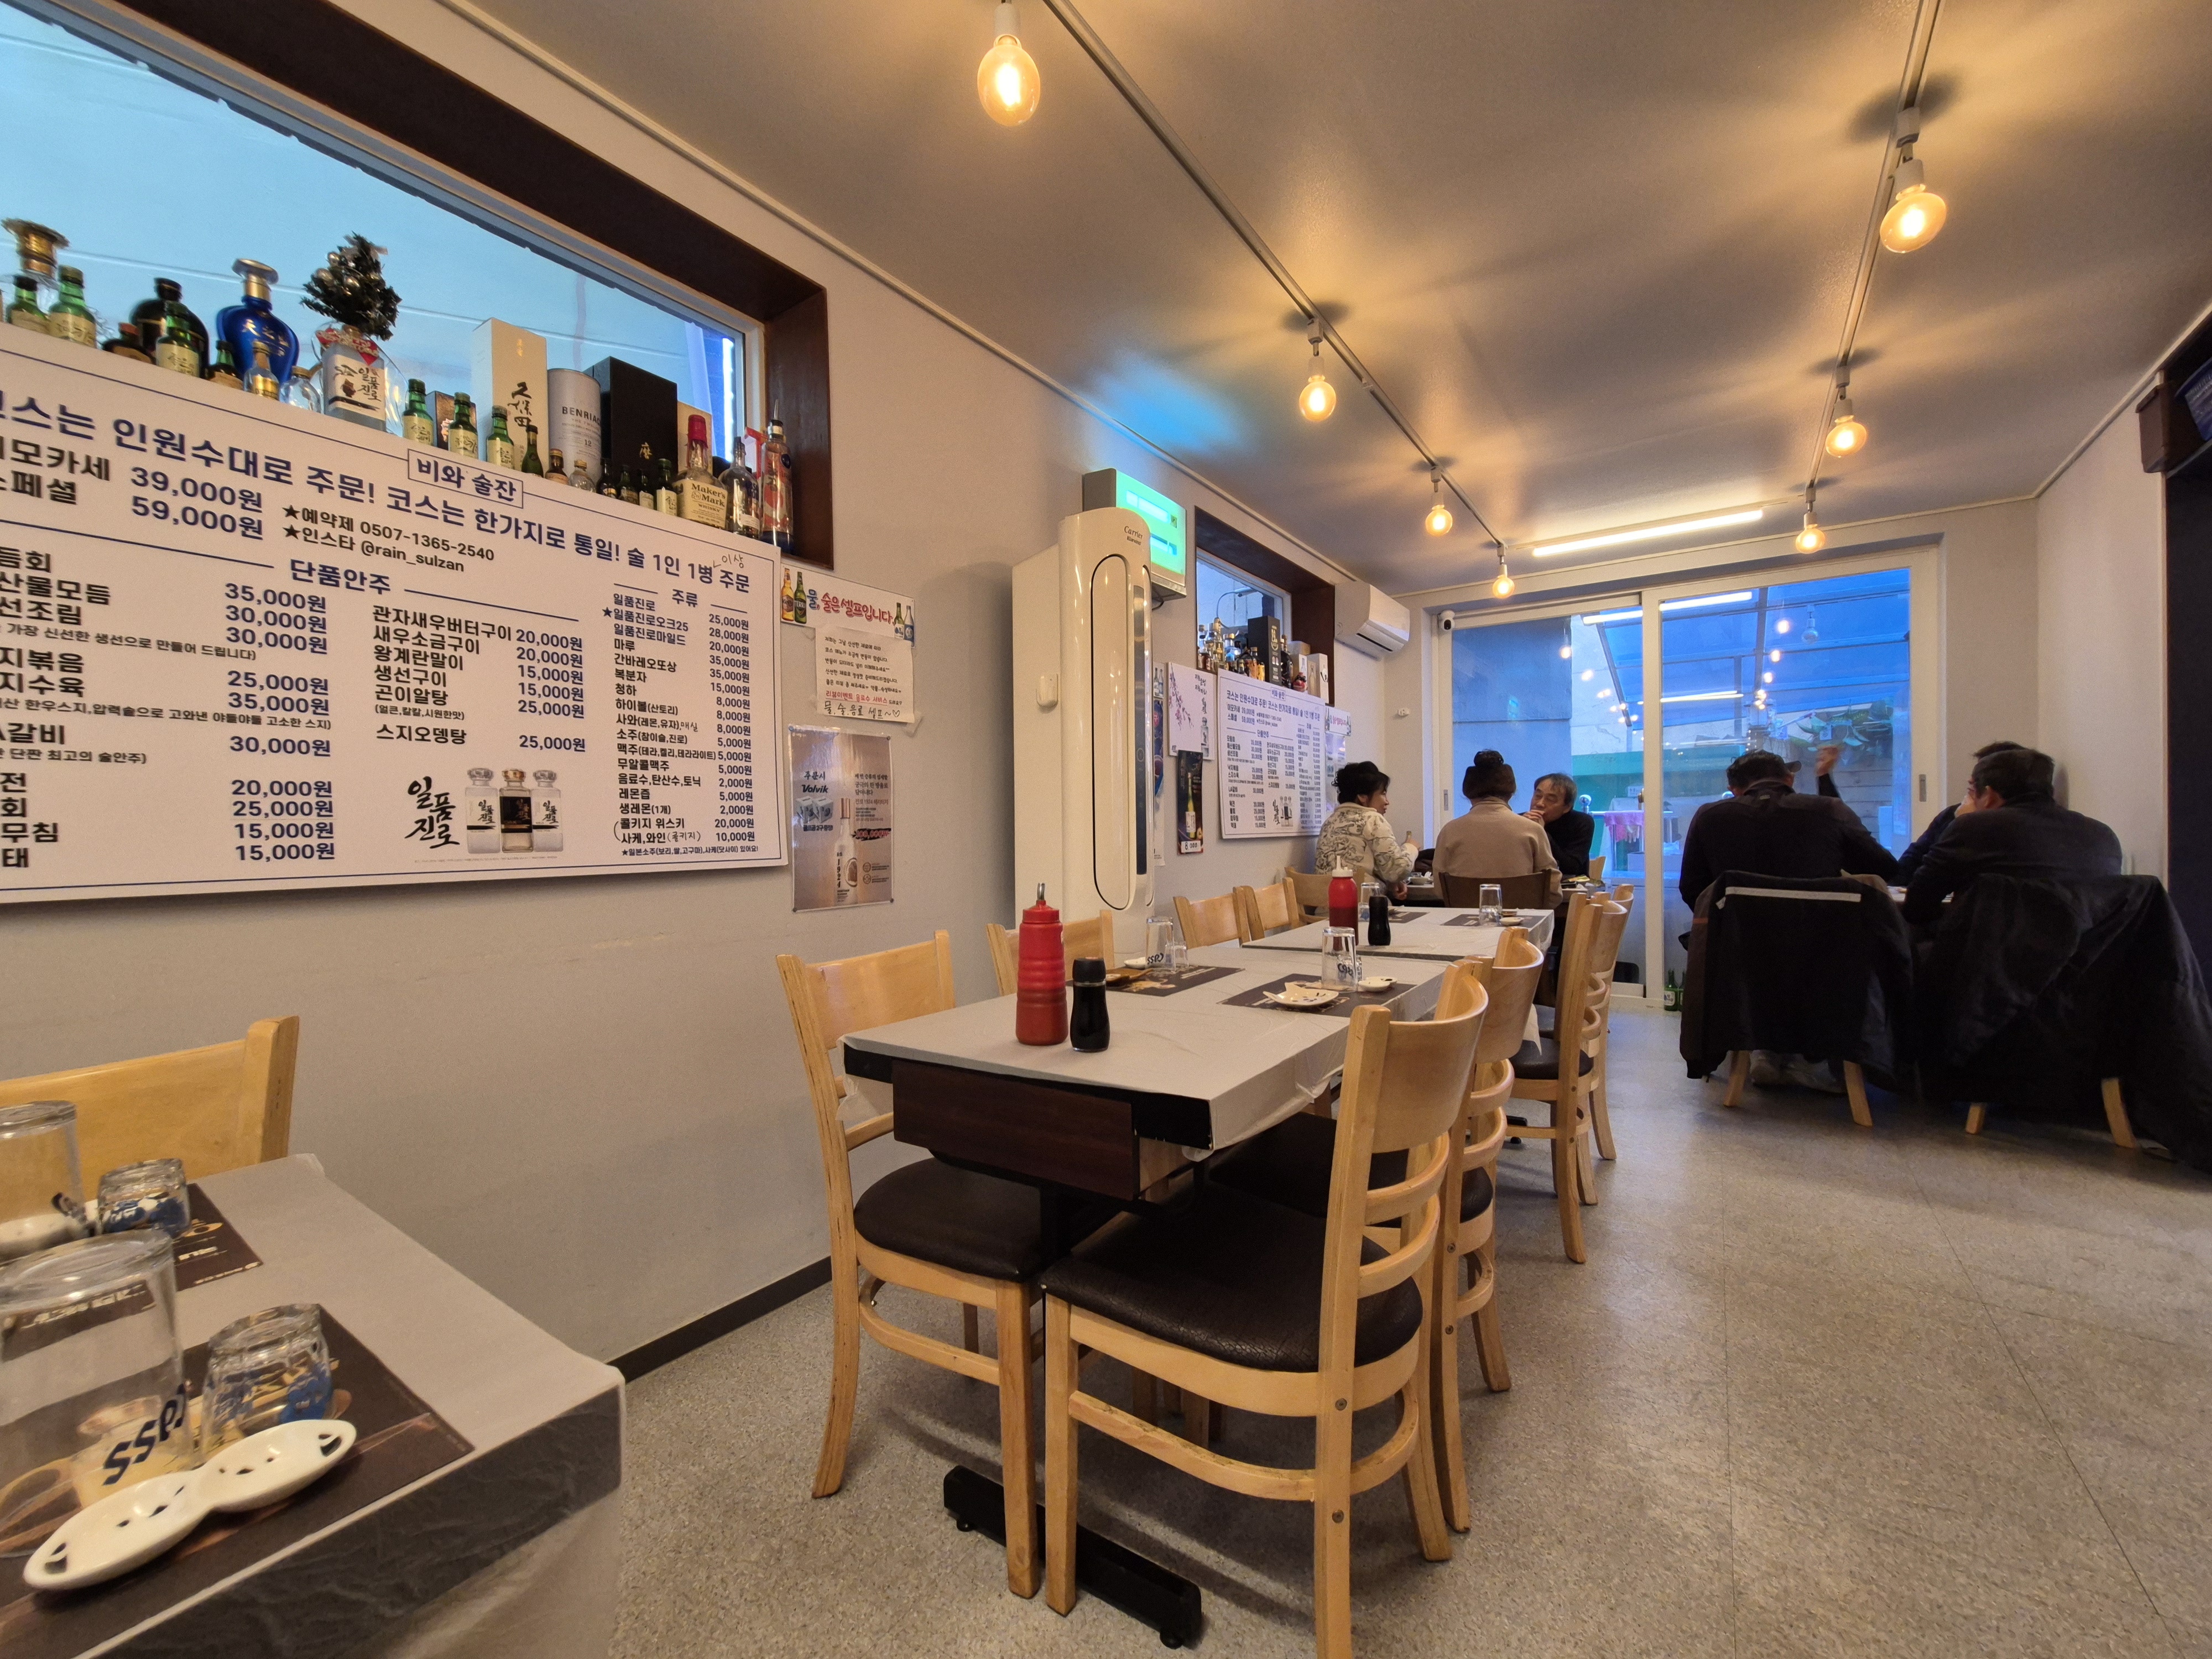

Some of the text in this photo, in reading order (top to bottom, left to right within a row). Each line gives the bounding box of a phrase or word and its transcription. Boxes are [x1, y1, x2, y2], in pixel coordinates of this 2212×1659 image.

[0, 436, 262, 513] 모카세 39,000원
[417, 458, 517, 502] 비와 술잔
[0, 390, 749, 593] 스는 인원수대로 주문! 코스는 한가지로 통일! 술 1인 1병 주문
[692, 483, 726, 499] Maker's
[701, 494, 725, 507] Mark
[0, 470, 263, 540] 페셜 59,000원
[361, 521, 494, 560] 0507-1365-2540
[1124, 526, 1143, 540] Carrier
[361, 539, 463, 572] @rain_sulzan
[722, 552, 744, 568] 이상
[291, 559, 390, 594] 단품안주
[225, 583, 326, 613] 35,000원
[672, 589, 697, 607] 주류
[226, 605, 326, 634] 30,000원
[614, 593, 748, 630] 일품진로 25,000원
[373, 605, 582, 652] 관자새우버터구이 20,000원
[614, 608, 749, 644] 일품진로오크25 28,000원
[8, 623, 255, 660] 가장 신선한 생선으로 만들어 드립니다)
[226, 627, 327, 654] 30,000원
[373, 625, 583, 669] 새우소금구이 20,000원
[614, 623, 749, 657] 일품진로마일드 20,000원
[374, 644, 583, 685] 왕계란말이 15,000원
[614, 638, 749, 670] 마루 35,000원
[614, 653, 749, 683] 간바레오또상 35,000원
[228, 671, 328, 695] 25,000원
[374, 665, 583, 702] 생선구이 15,000원
[615, 668, 749, 696] 복분자 15,000원
[228, 692, 329, 716] 35,000원
[375, 684, 584, 718] 곤이알탕 25,000원
[615, 683, 750, 709] 청하 8,000원
[826, 691, 853, 700] 리뷰이벤트
[856, 694, 870, 702] 음료수
[169, 709, 207, 721] 고와낸
[213, 713, 262, 725] 야들야들
[267, 716, 301, 727] 고소한
[305, 719, 331, 729] 스지)
[615, 698, 750, 723] 하이볼(산토리) 8,000원
[377, 724, 585, 752] 스지오뎅탕 25,000원
[617, 728, 751, 749] 소주(참이슬,진로) 5,000원
[717, 724, 750, 736] 8,000원
[48, 750, 92, 761] 최고의
[98, 752, 147, 764] 술안주)
[230, 736, 330, 757] 30,000원
[718, 751, 751, 762] 5,000원
[618, 758, 752, 775] 무알콜맥주 5,000원
[804, 771, 825, 781] 주문시
[0, 773, 332, 797] 전 20,000원
[618, 773, 752, 789] 음료수,탄산수,토닉 2,000원
[801, 784, 828, 793] Volvik
[1, 797, 333, 818] 회 25,000원
[619, 788, 753, 802] 레몬즙 5,000원
[619, 803, 753, 815] 생레몬(1개) 2,000원
[1, 822, 333, 843] 무침 15,000원
[620, 818, 754, 829] 콜키지 위스키 20,000원
[716, 832, 755, 842] 10,000원
[2, 843, 335, 868] 태 15,000원
